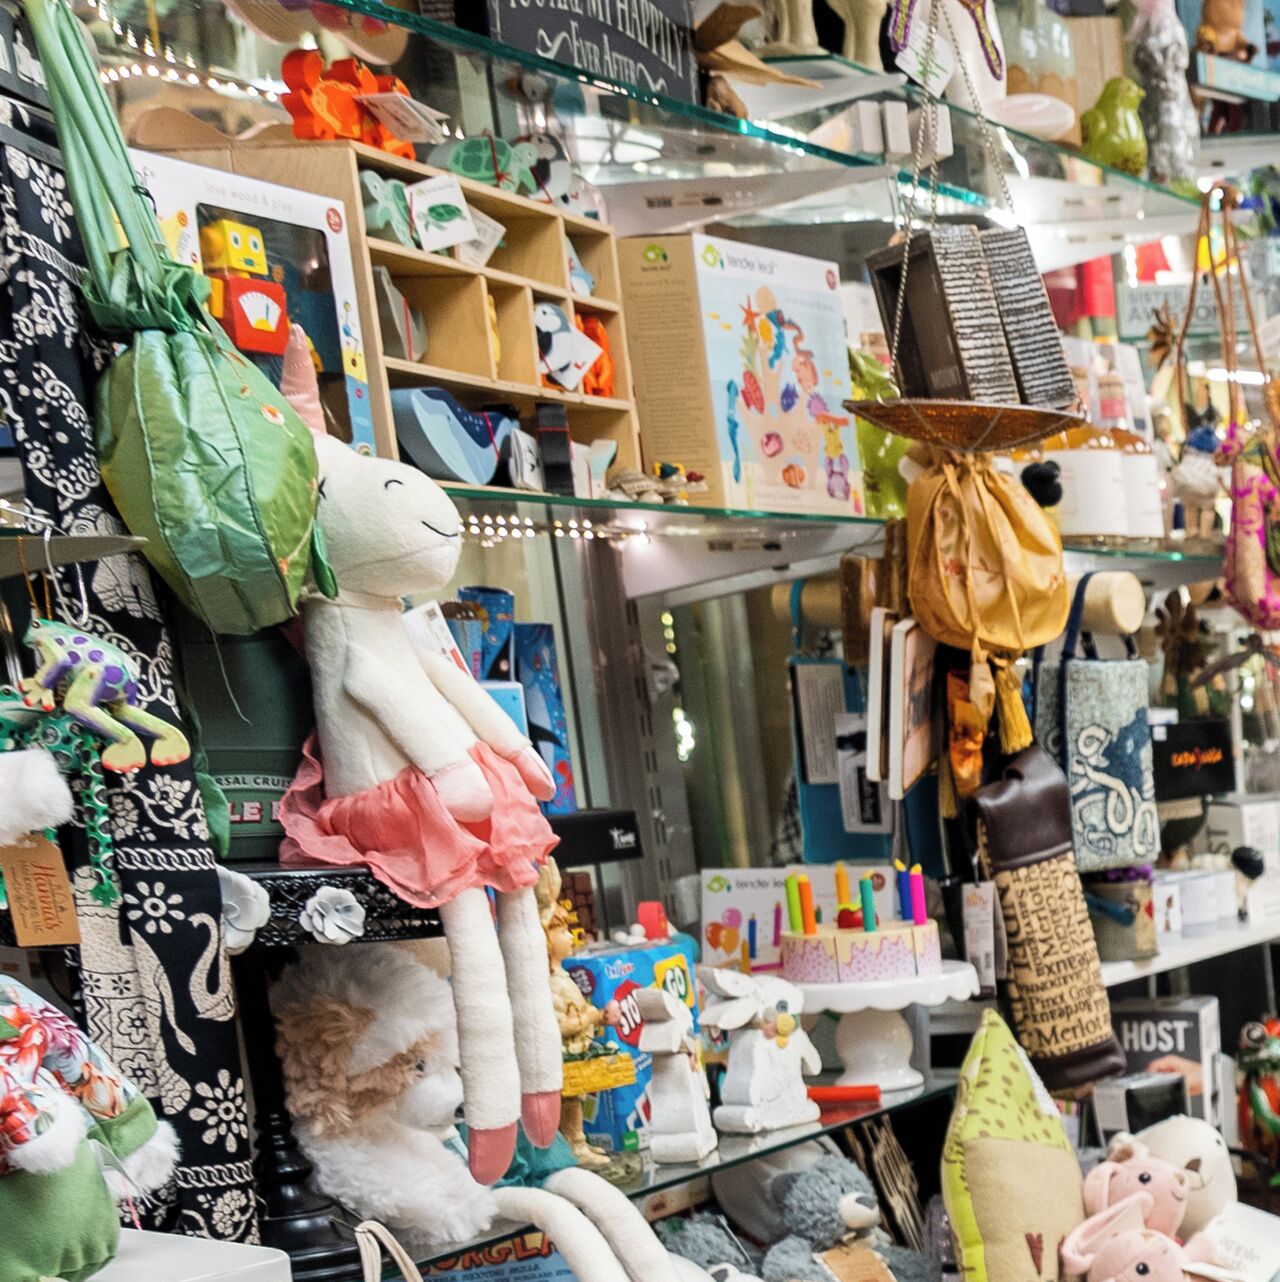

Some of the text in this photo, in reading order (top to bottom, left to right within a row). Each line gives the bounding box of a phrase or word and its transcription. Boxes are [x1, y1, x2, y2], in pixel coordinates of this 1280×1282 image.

[211, 775, 295, 790] RSAL CRUIS
[665, 965, 686, 1001] GO
[619, 987, 645, 1038] STO
[1034, 1015, 1101, 1048] Merlot
[1121, 1020, 1190, 1053] HOST
